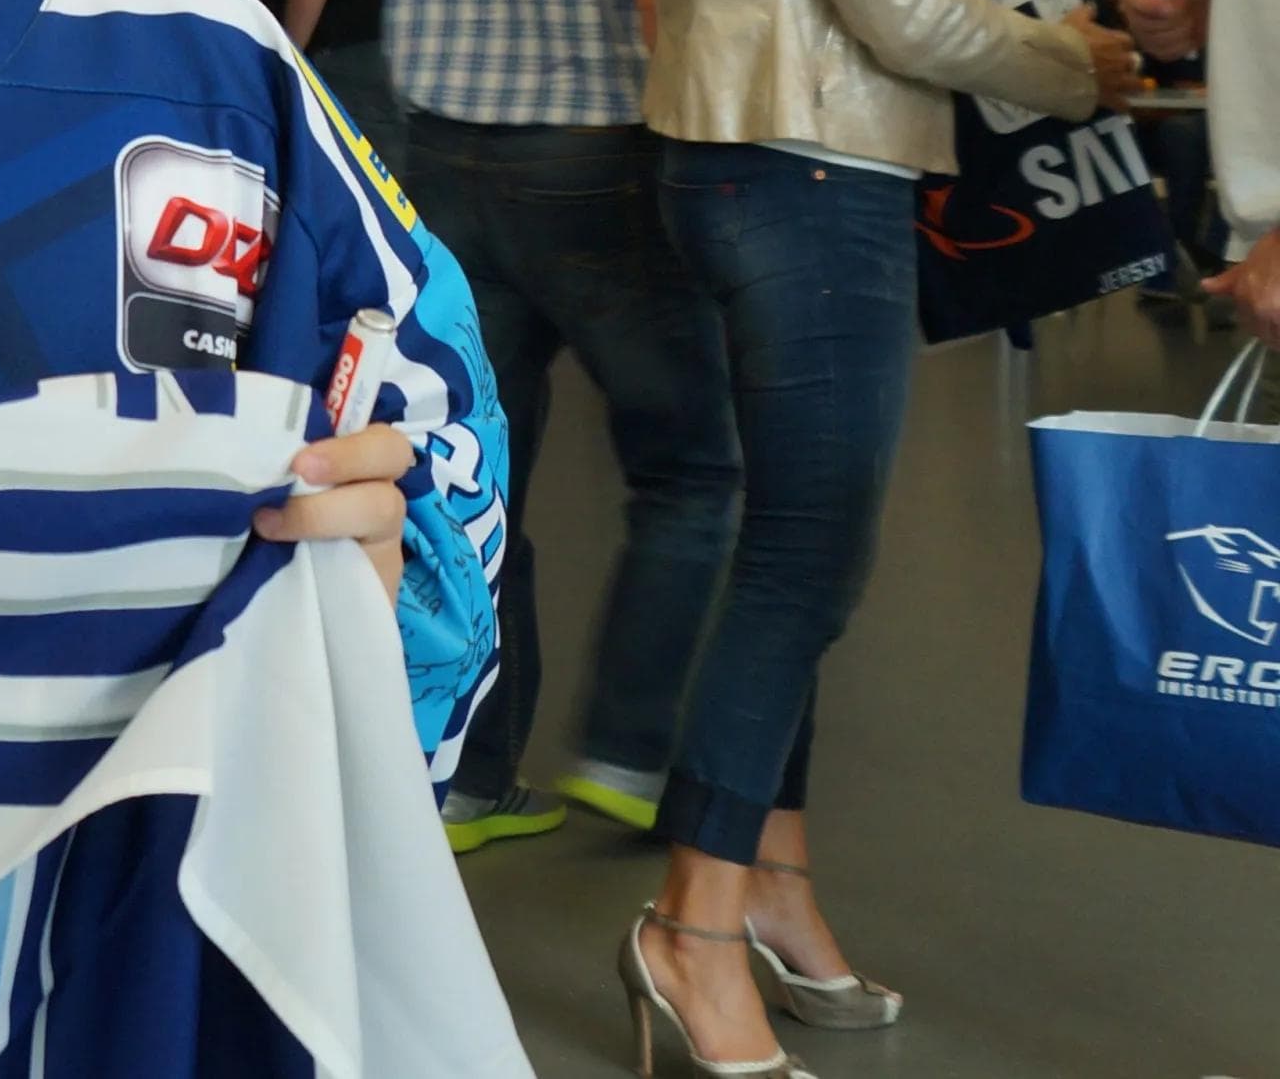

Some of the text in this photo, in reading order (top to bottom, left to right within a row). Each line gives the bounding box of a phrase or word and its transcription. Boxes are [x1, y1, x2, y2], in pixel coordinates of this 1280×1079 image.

[183, 329, 238, 360] CASH
[1157, 650, 1280, 691] ERC
[1157, 679, 1280, 707] INGOLSTAD
